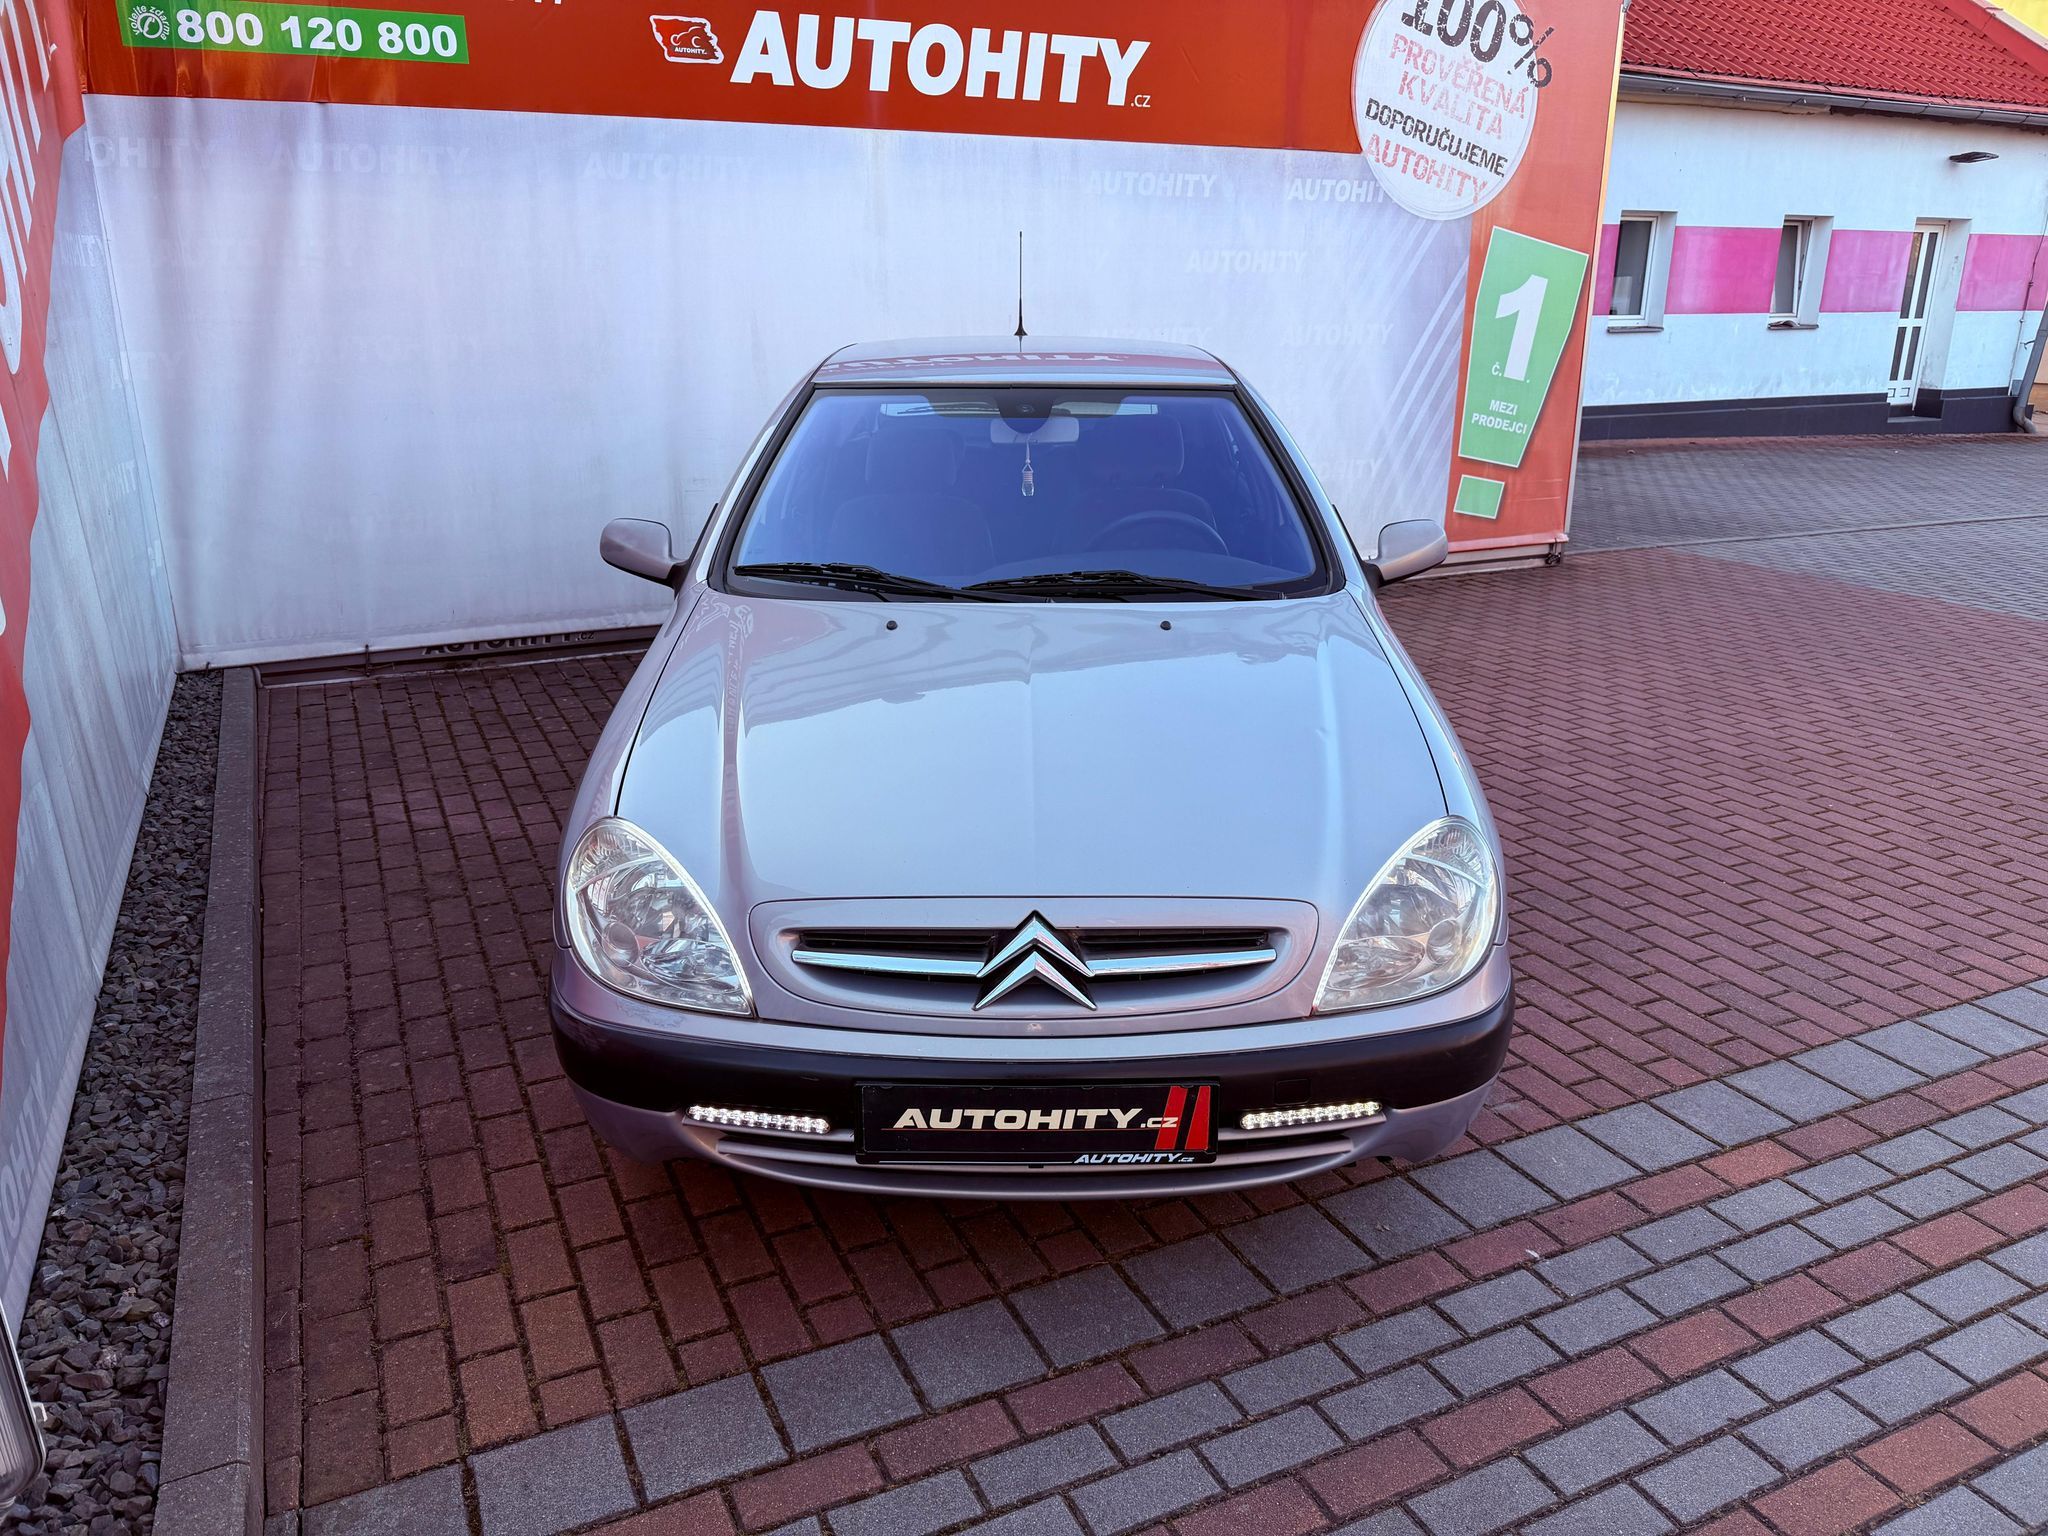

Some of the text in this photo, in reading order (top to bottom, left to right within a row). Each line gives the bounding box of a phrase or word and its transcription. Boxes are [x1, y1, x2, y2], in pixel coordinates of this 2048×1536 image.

[176, 9, 457, 57] 800 120 800
[1389, 33, 1529, 119] PROVĚŘENÁ
[1398, 70, 1503, 140] KVALITA
[1365, 97, 1508, 178] DOPORUČUJEME
[1084, 171, 1218, 198] AUTOHITY
[1287, 178, 1396, 203] AUTOHIT
[1366, 133, 1488, 206] AUTOHITY
[1471, 412, 1527, 434] PRODEJCI
[1489, 400, 1518, 416] MEZI
